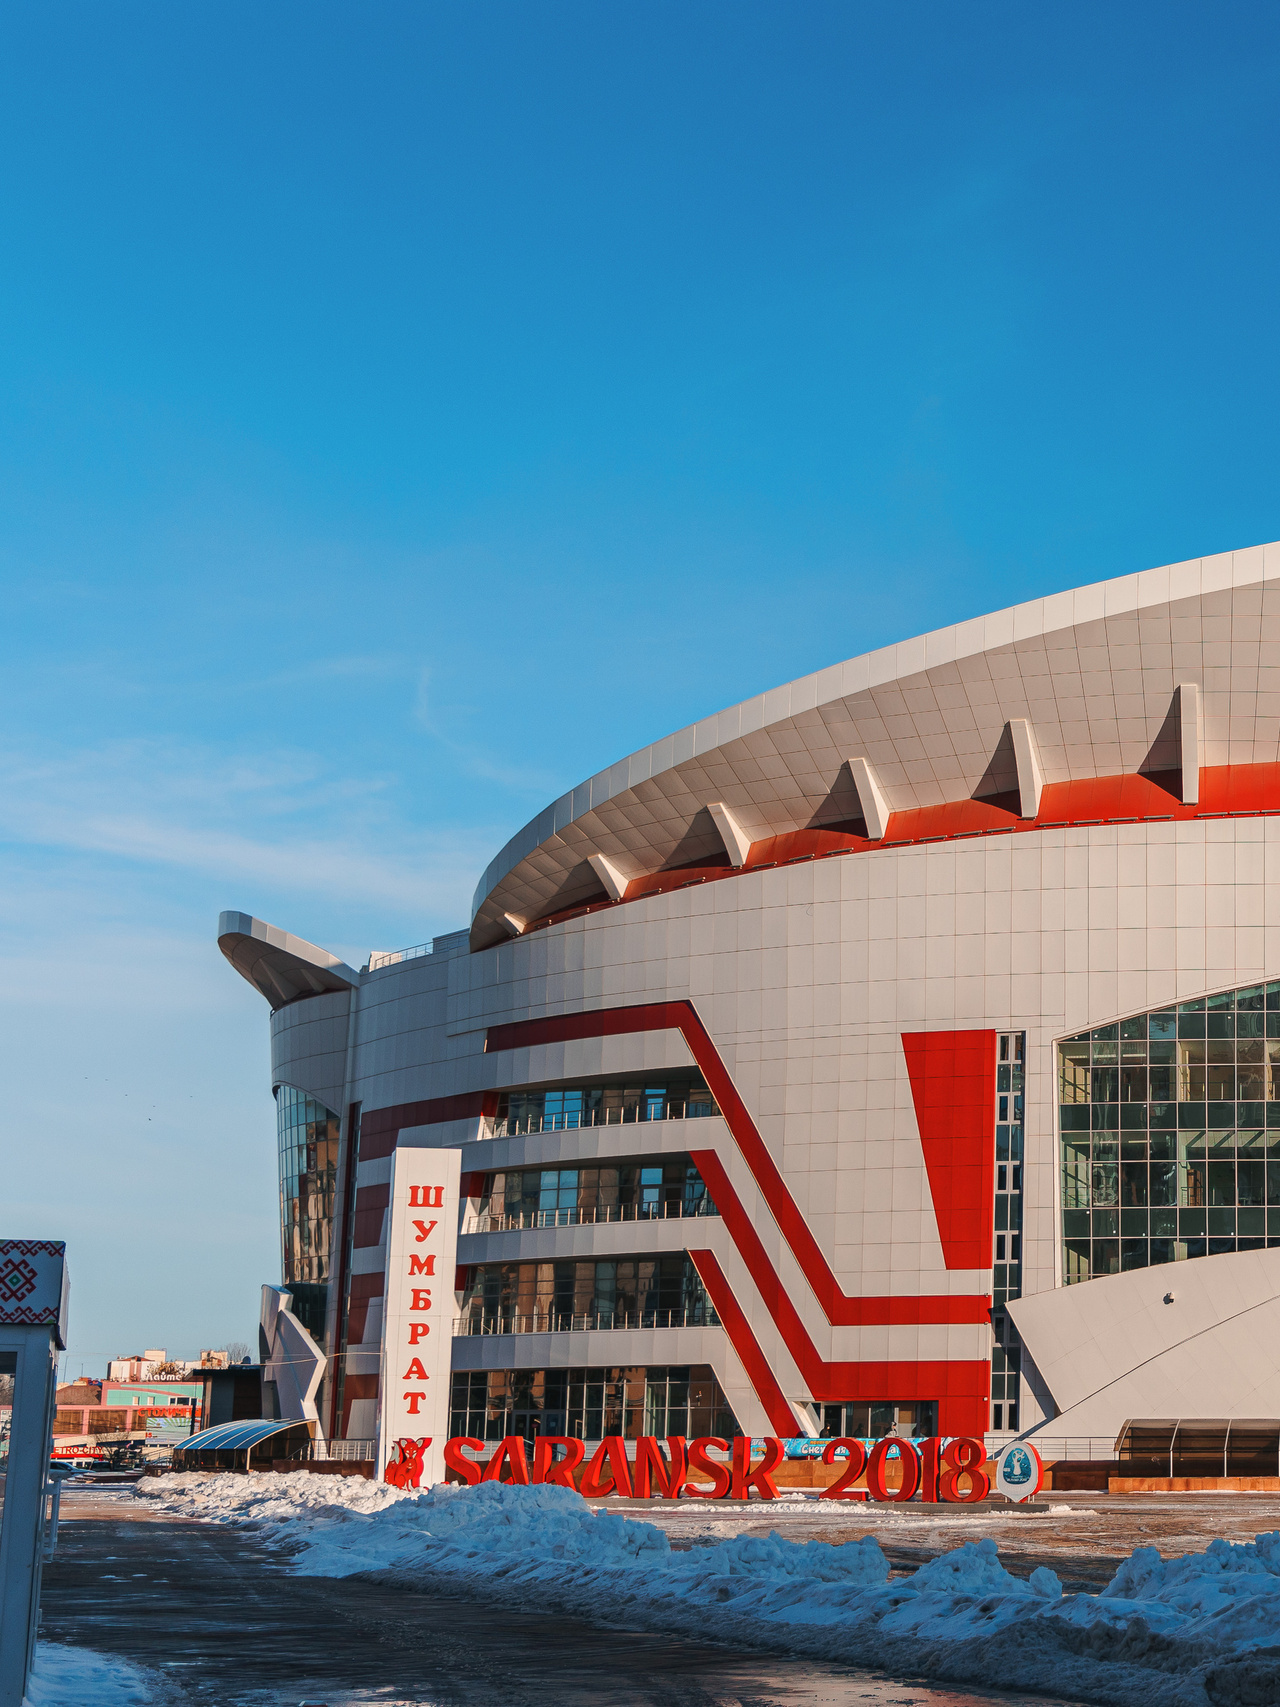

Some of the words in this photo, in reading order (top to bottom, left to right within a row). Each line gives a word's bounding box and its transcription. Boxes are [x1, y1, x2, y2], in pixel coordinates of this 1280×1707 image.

[402, 1185, 444, 1414] ШУМБРАТ
[137, 1407, 202, 1417] СТОЛИЧНЫ
[53, 1446, 103, 1454] ETRO-CITY
[444, 1435, 784, 1500] SARANSK
[818, 1437, 990, 1503] 2018
